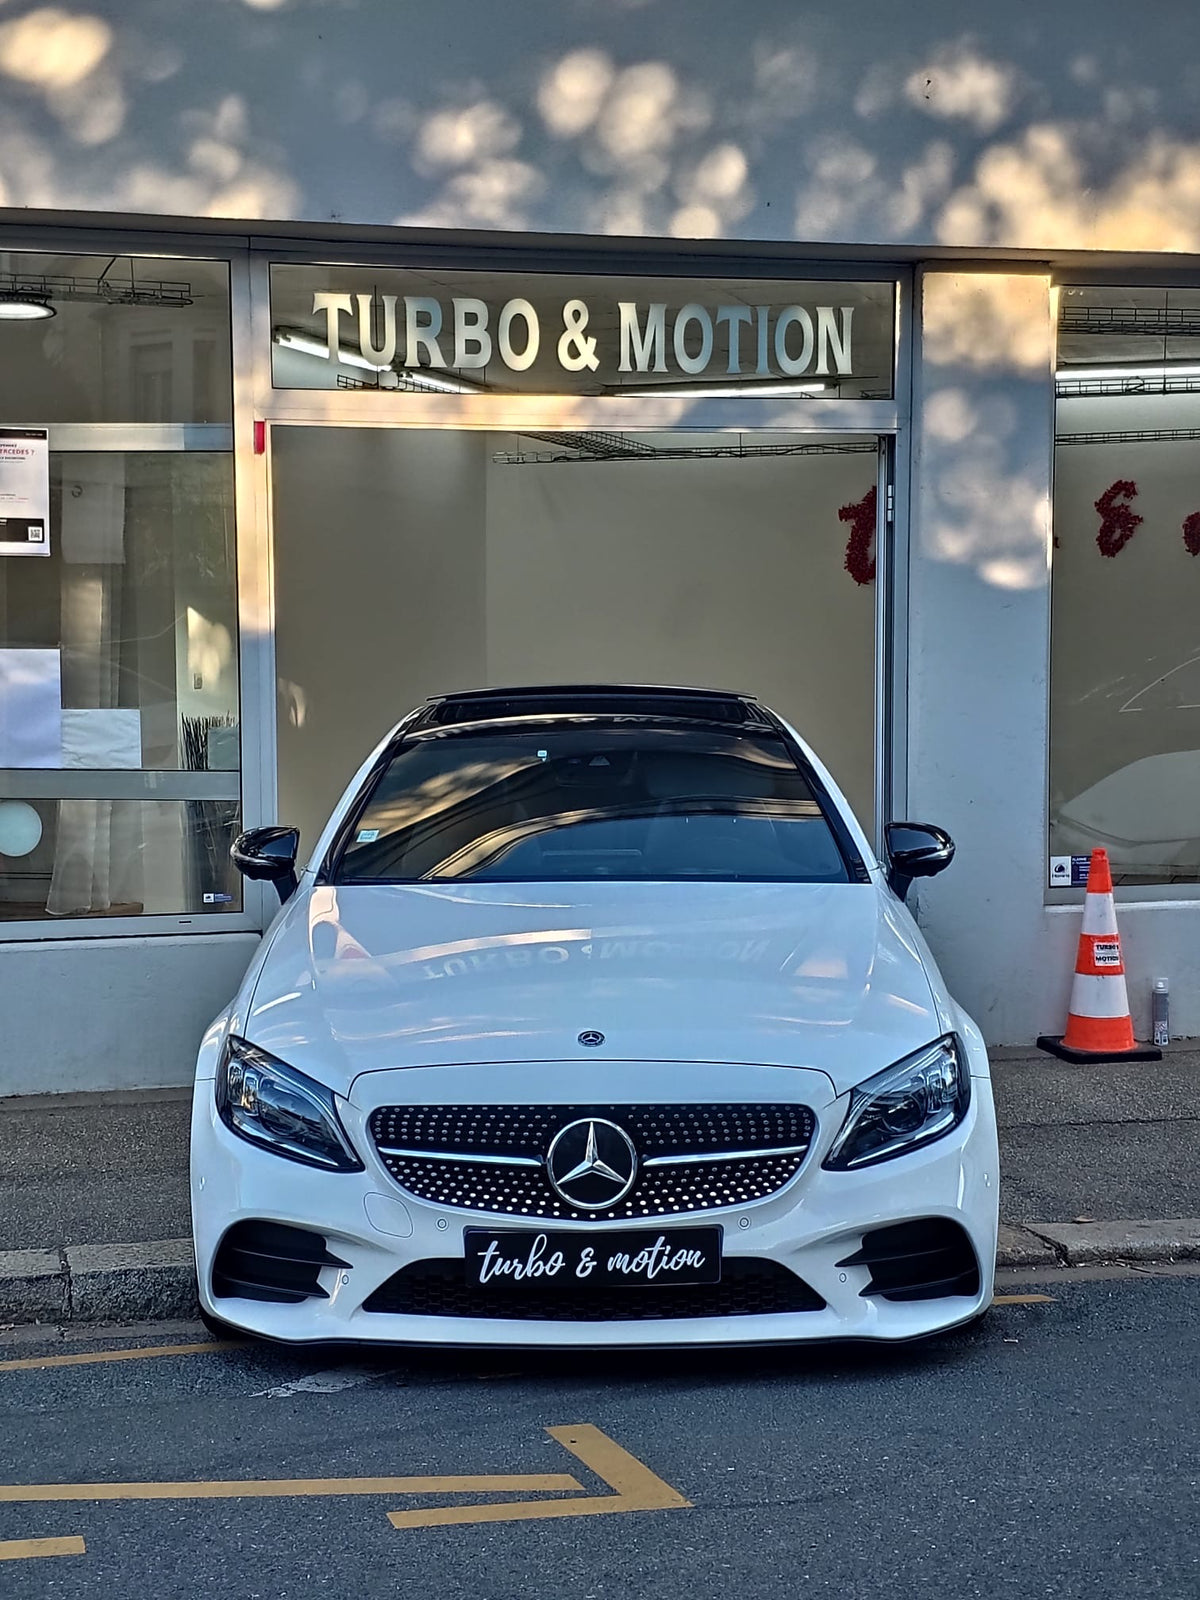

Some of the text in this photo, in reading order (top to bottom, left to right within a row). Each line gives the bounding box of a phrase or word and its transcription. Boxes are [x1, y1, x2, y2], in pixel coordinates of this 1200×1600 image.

[312, 293, 856, 375] TURBO & MOTION
[477, 1233, 706, 1284] turbo & motion
